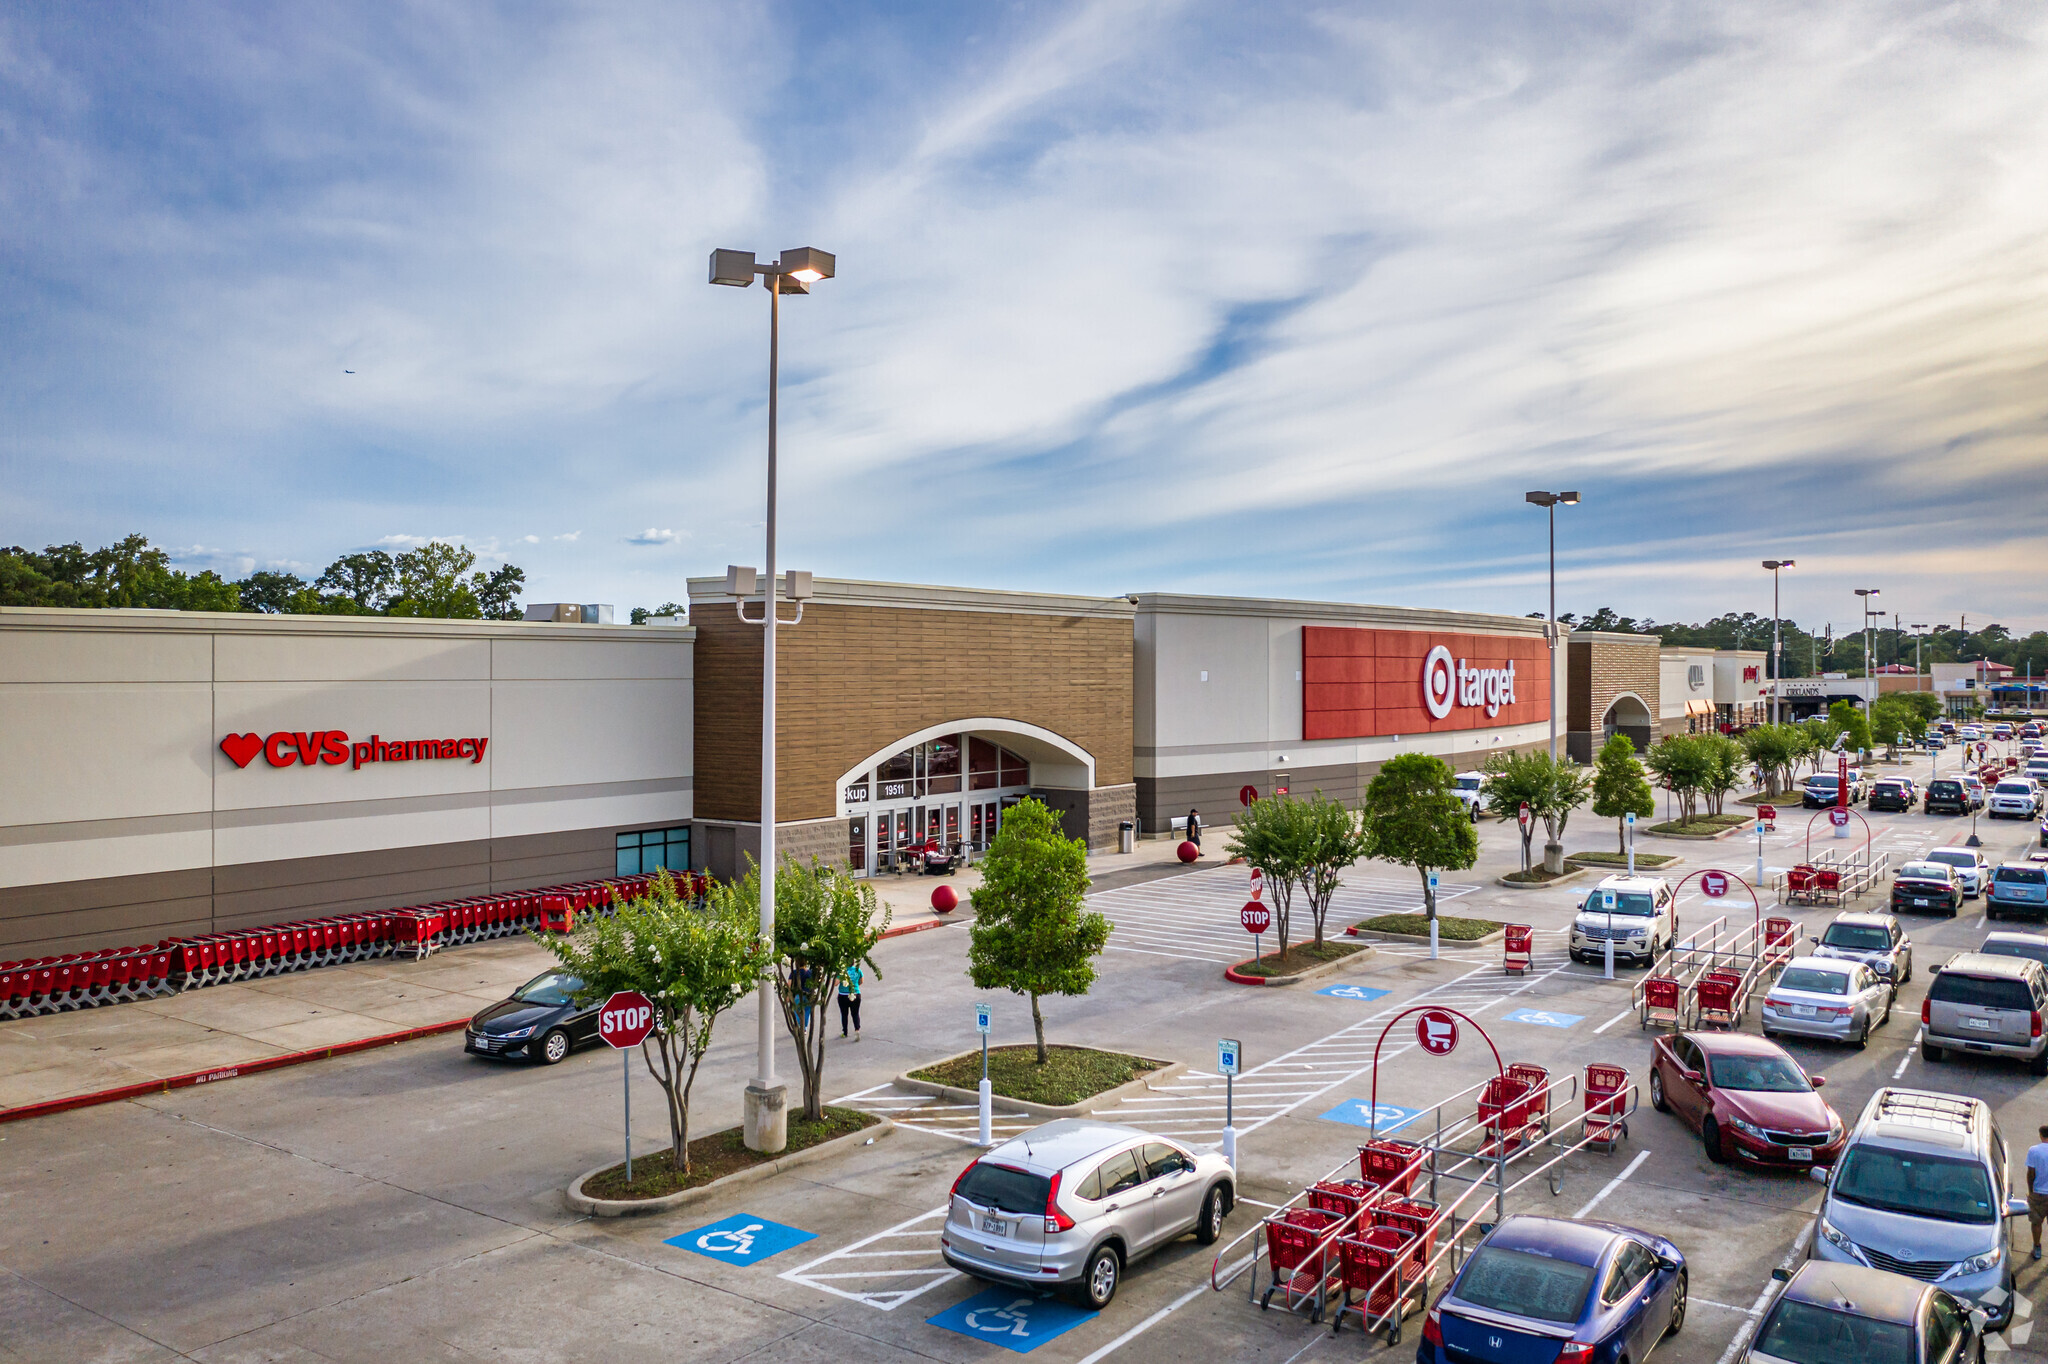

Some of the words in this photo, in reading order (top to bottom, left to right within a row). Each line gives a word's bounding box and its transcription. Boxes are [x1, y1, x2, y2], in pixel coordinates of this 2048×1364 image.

[1457, 658, 1516, 718] target
[263, 730, 350, 768] CVS
[352, 734, 489, 770] pharmacy
[885, 783, 904, 796] 19511
[1251, 876, 1262, 893] STOP
[1242, 911, 1269, 925] STOP
[602, 1006, 651, 1034] STOP
[208, 1068, 238, 1081] PARKING
